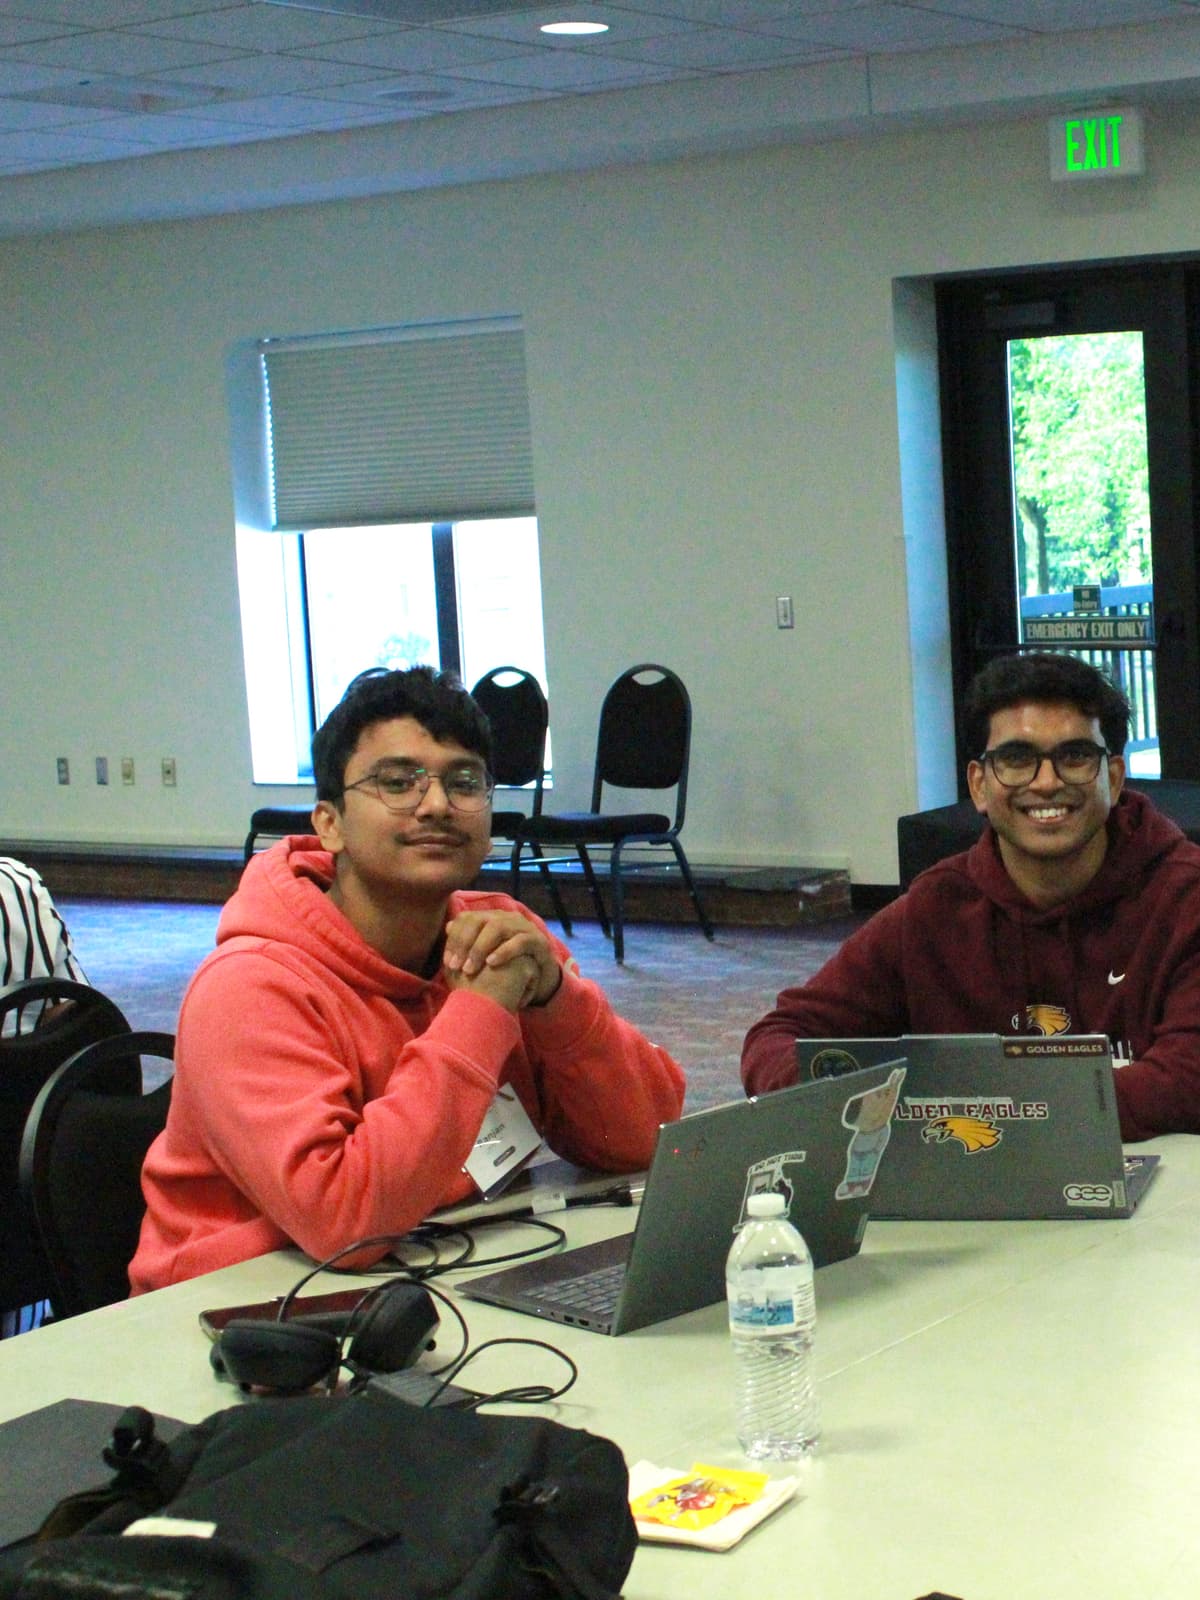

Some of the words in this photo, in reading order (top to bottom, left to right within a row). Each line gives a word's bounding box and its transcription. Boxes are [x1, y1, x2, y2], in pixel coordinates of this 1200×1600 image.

[1066, 116, 1122, 171] EXIT
[1026, 622, 1088, 639] EMERGENCY
[1091, 622, 1114, 638] EXIT
[1118, 622, 1145, 638] ONLY
[1026, 1045, 1066, 1054] GOLDEN
[1067, 1044, 1103, 1053] EAGLES
[898, 1103, 951, 1119] LDEN
[967, 1103, 1048, 1119] EAGLES
